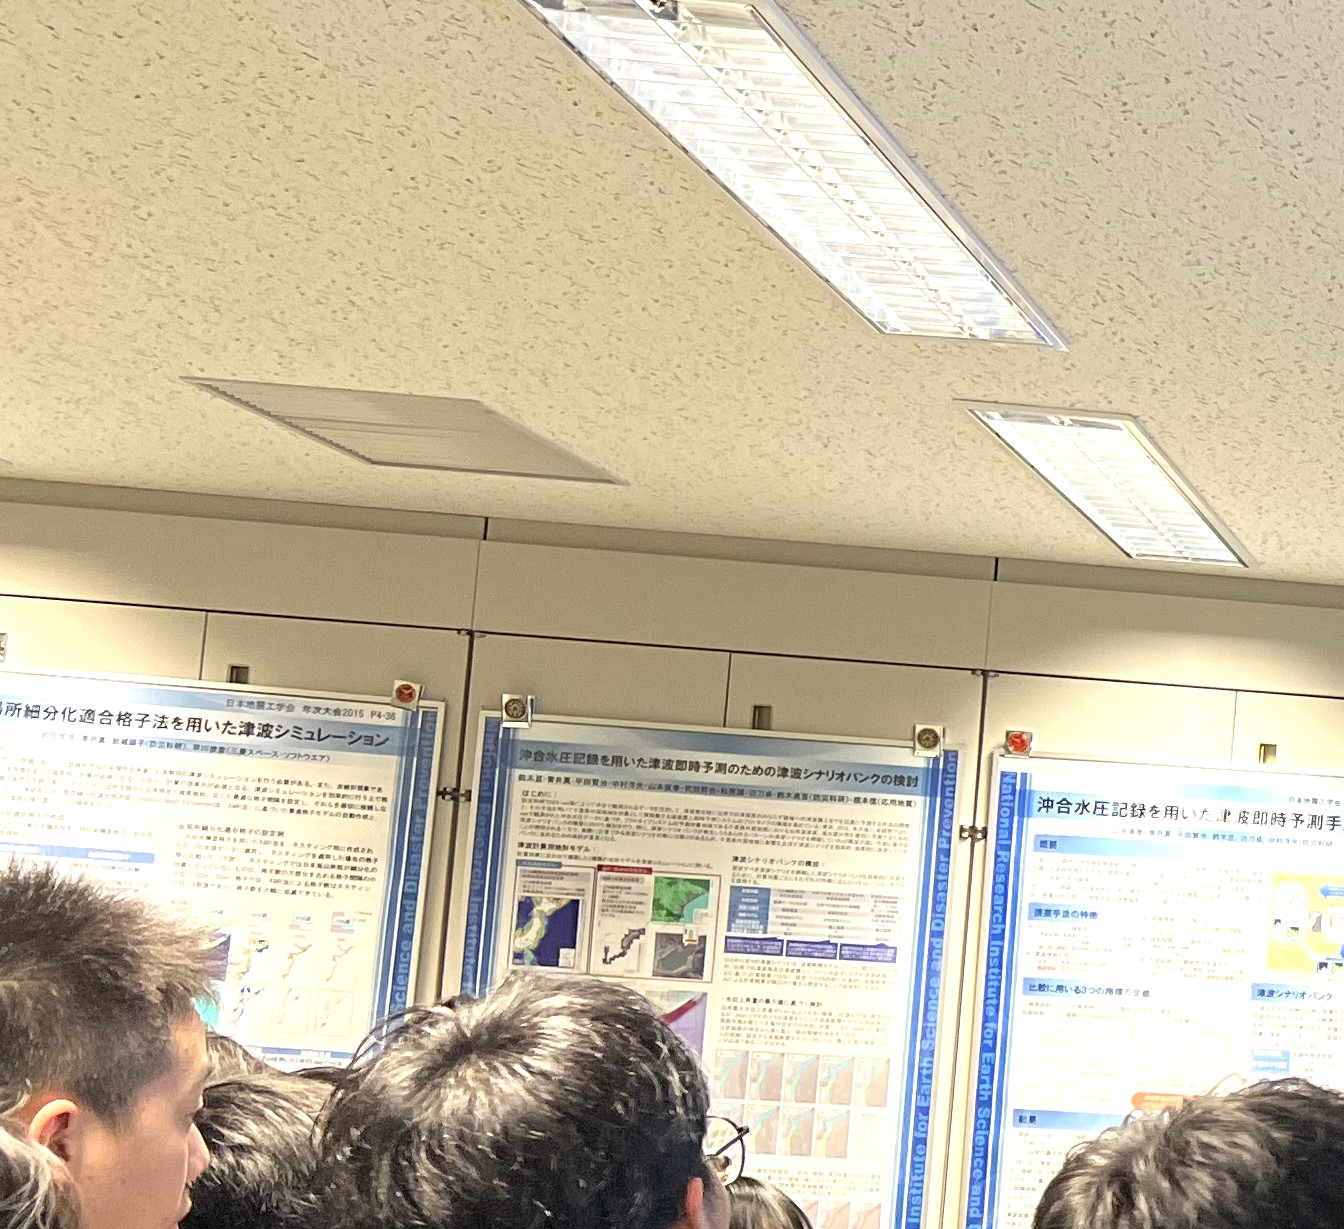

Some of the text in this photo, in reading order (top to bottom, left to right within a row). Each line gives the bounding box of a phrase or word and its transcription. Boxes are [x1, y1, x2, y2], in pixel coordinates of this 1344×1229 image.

[0, 701, 390, 747] 所細分化適合格子法を用いた津波シミュレーション
[937, 751, 958, 850] Prevention
[997, 772, 1017, 844] National
[930, 855, 950, 931] Disaster
[991, 850, 1013, 934] Research
[926, 937, 945, 972] and
[984, 940, 1005, 1017] Institute
[919, 976, 941, 1051] Science
[982, 1021, 999, 1048] for
[916, 1056, 934, 1108] Earth
[976, 1052, 996, 1100] Earth
[912, 1113, 929, 1139] for
[972, 1107, 990, 1180] Science
[904, 1143, 927, 1223] Institute
[967, 1184, 985, 1218] and
